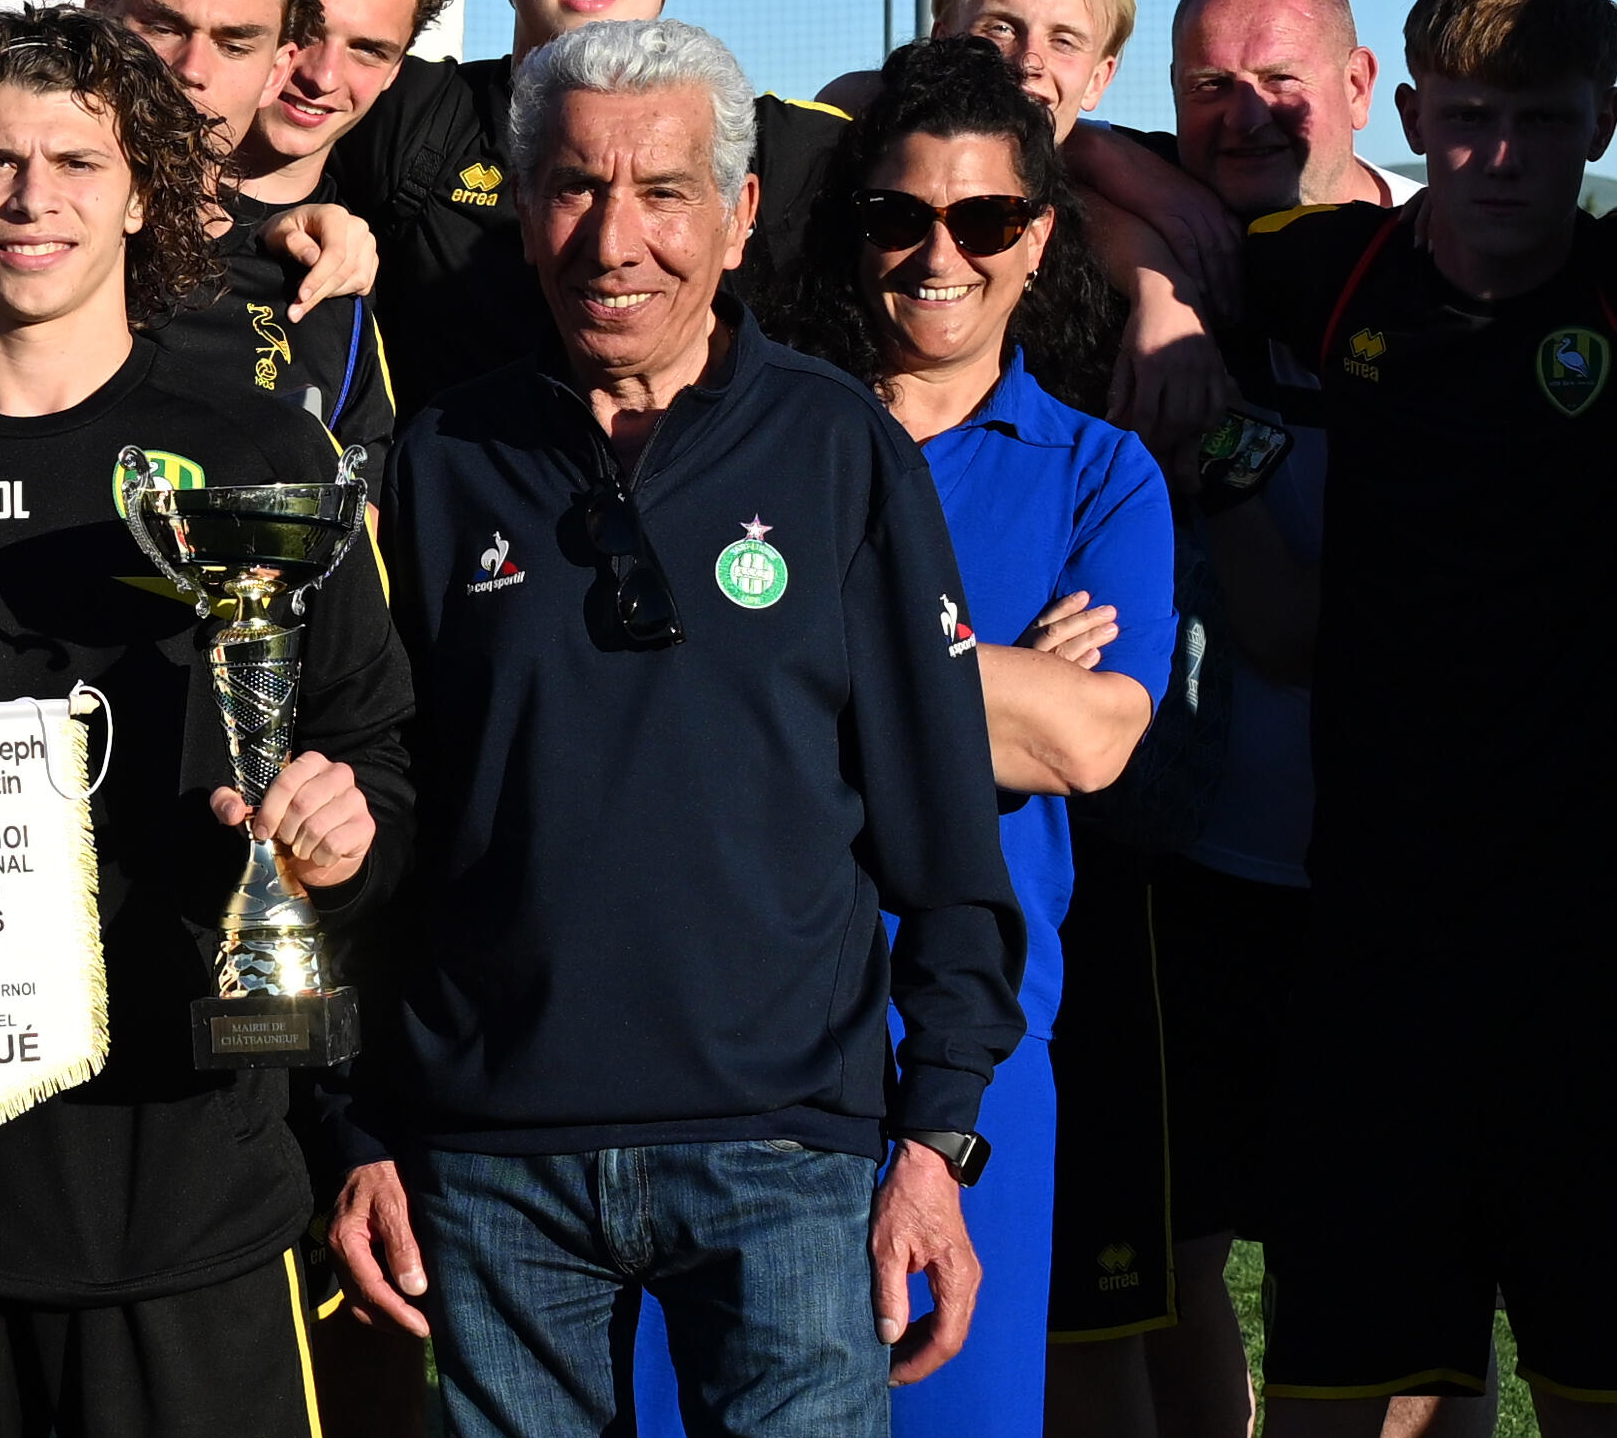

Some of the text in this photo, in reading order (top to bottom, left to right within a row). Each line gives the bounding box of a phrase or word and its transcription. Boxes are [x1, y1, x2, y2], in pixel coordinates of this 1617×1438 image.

[450, 188, 499, 206] errea
[474, 581, 493, 594] coq
[493, 571, 526, 590] sportif
[231, 1022, 287, 1034] MAIRIE DE
[1097, 1271, 1142, 1292] errea
